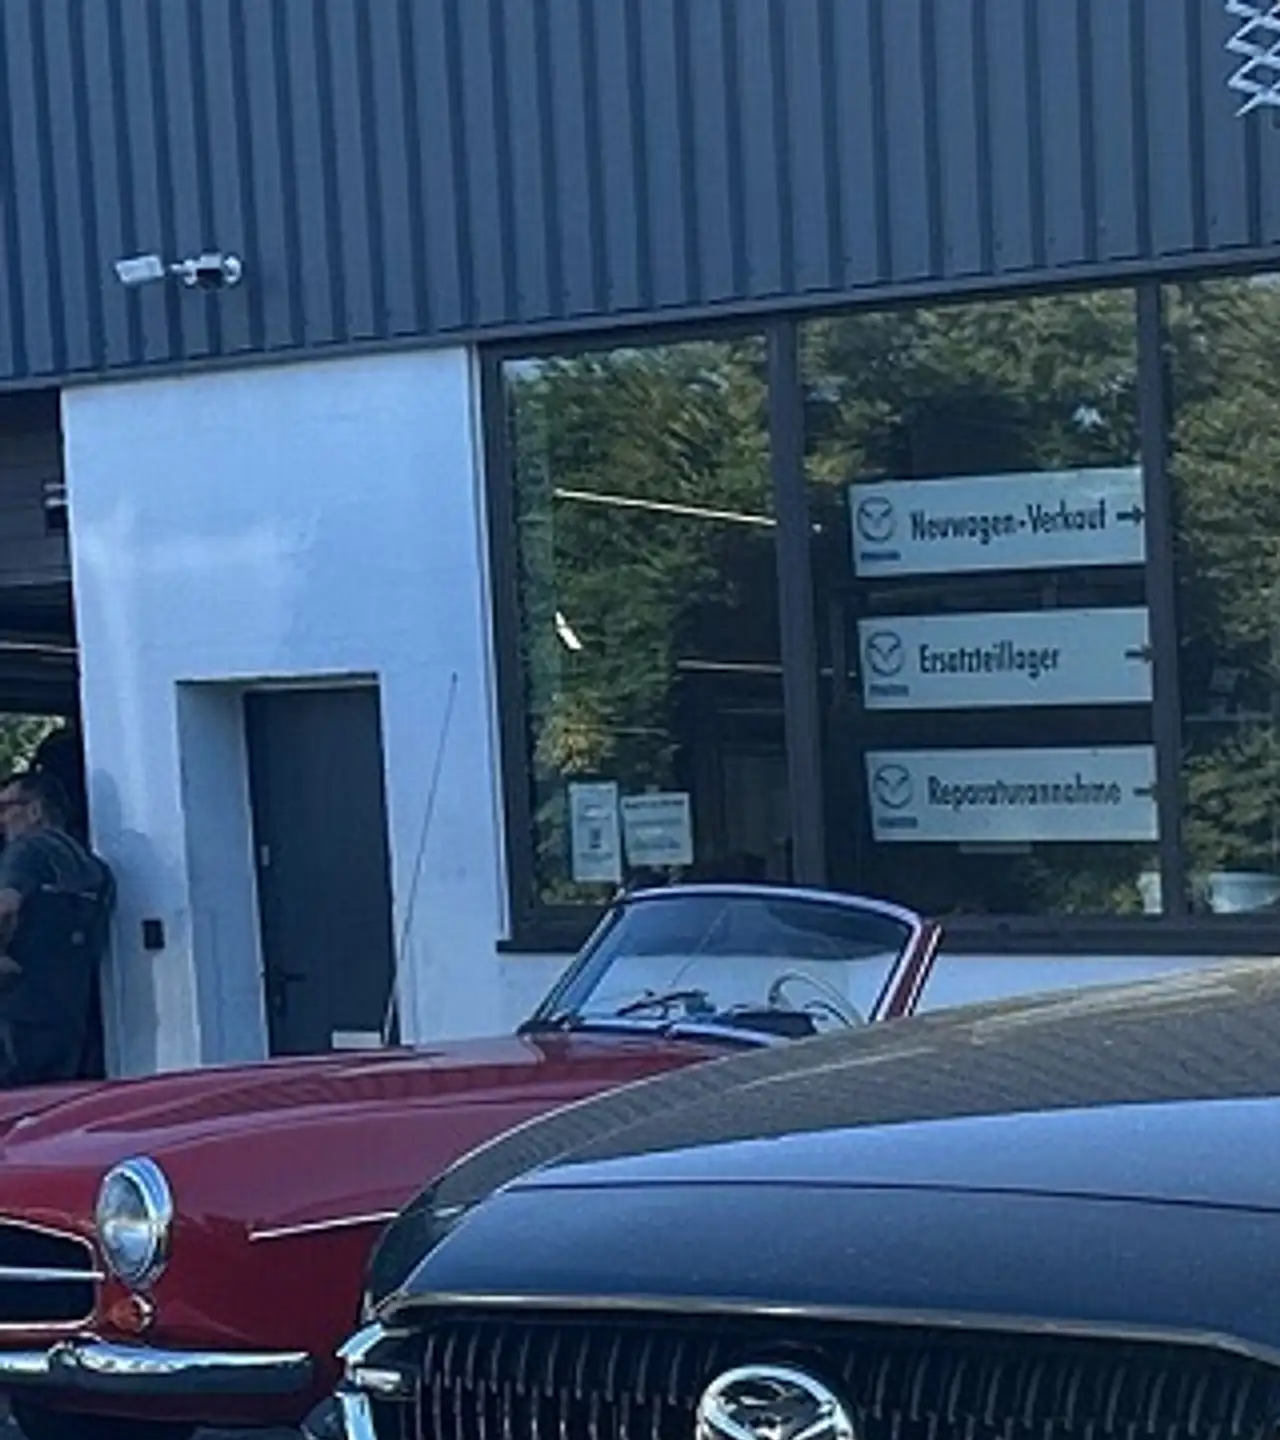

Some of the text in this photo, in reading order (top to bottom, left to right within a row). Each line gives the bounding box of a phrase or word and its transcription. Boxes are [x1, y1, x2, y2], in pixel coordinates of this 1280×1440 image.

[908, 497, 1107, 546] Neuwagen-Verkauf
[919, 640, 1061, 679] Ersatzteillager
[926, 772, 1122, 812] Reparaturannahme
